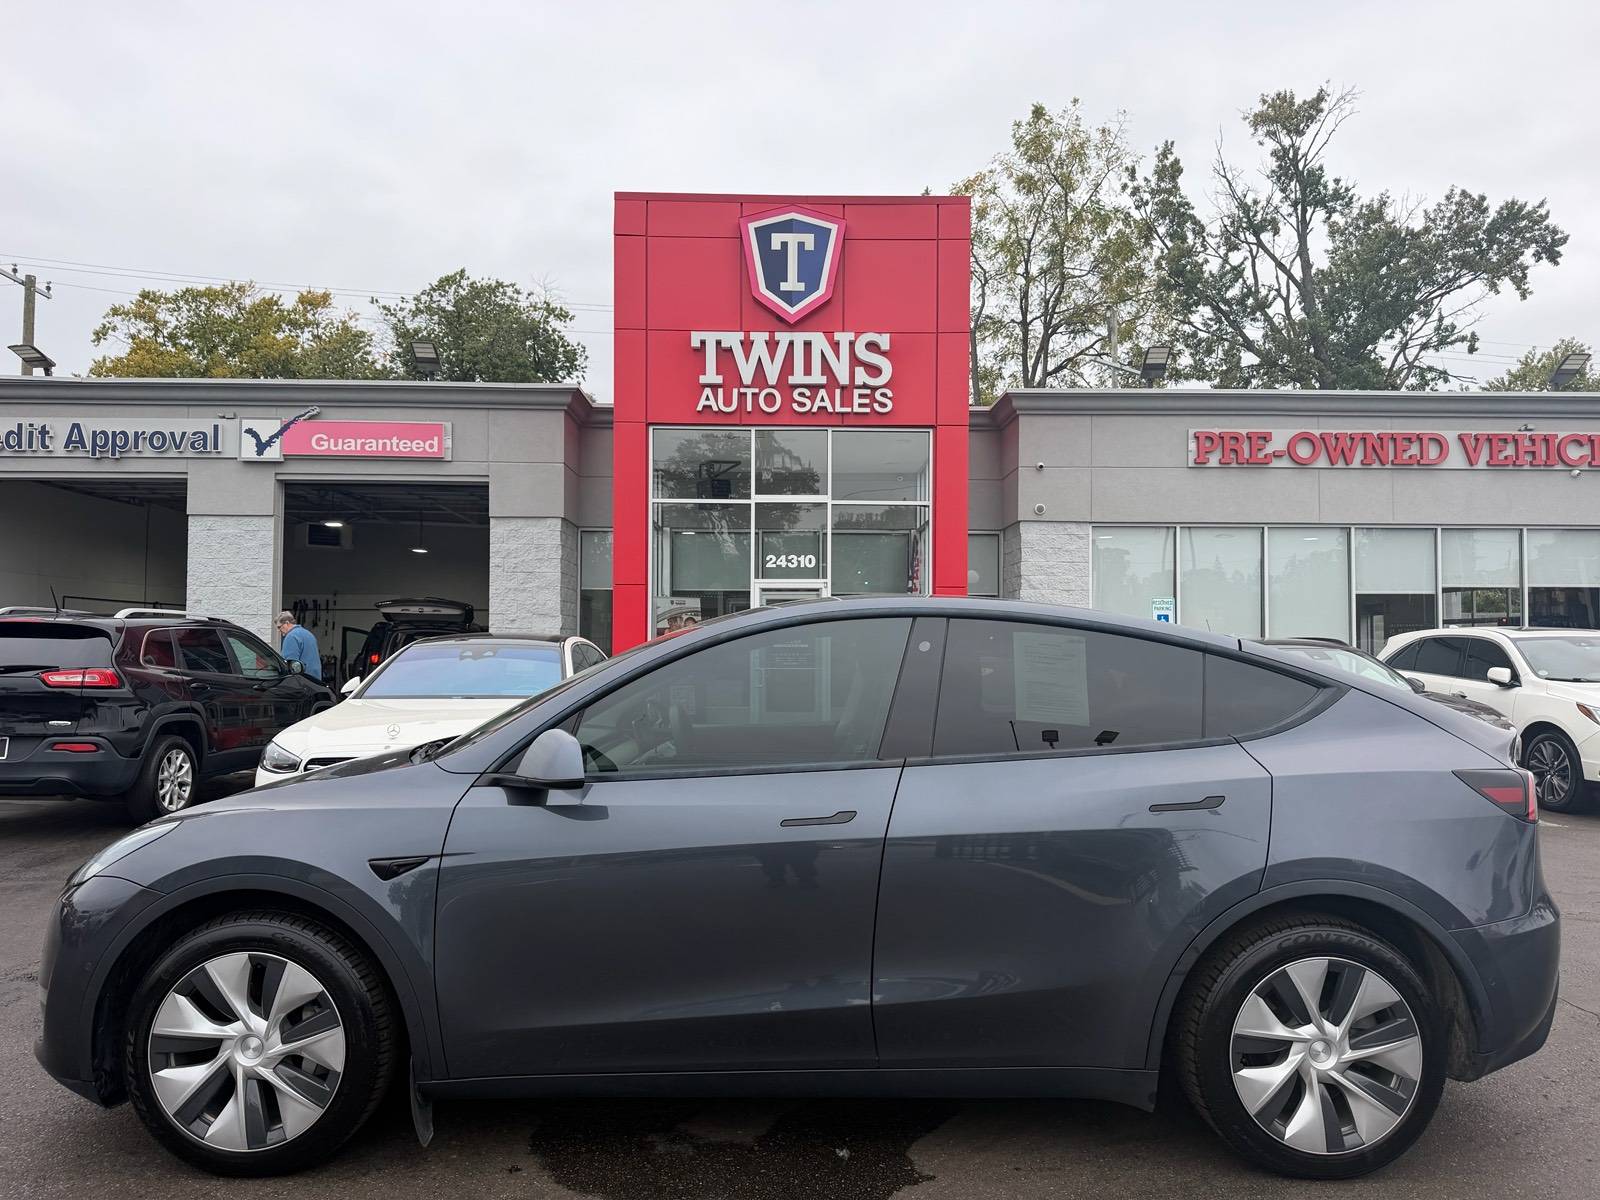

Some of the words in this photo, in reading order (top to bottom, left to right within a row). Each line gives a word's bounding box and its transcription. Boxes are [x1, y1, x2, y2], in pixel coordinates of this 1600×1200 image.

[770, 233, 815, 292] T
[690, 331, 894, 387] TWINS
[696, 387, 783, 414] AUTO
[791, 388, 894, 414] SALES
[0, 422, 51, 450] dit
[63, 422, 222, 458] Approval
[311, 433, 440, 453] Guaranteed
[1194, 431, 1450, 467] PRE-OWNED
[765, 554, 817, 568] 24310
